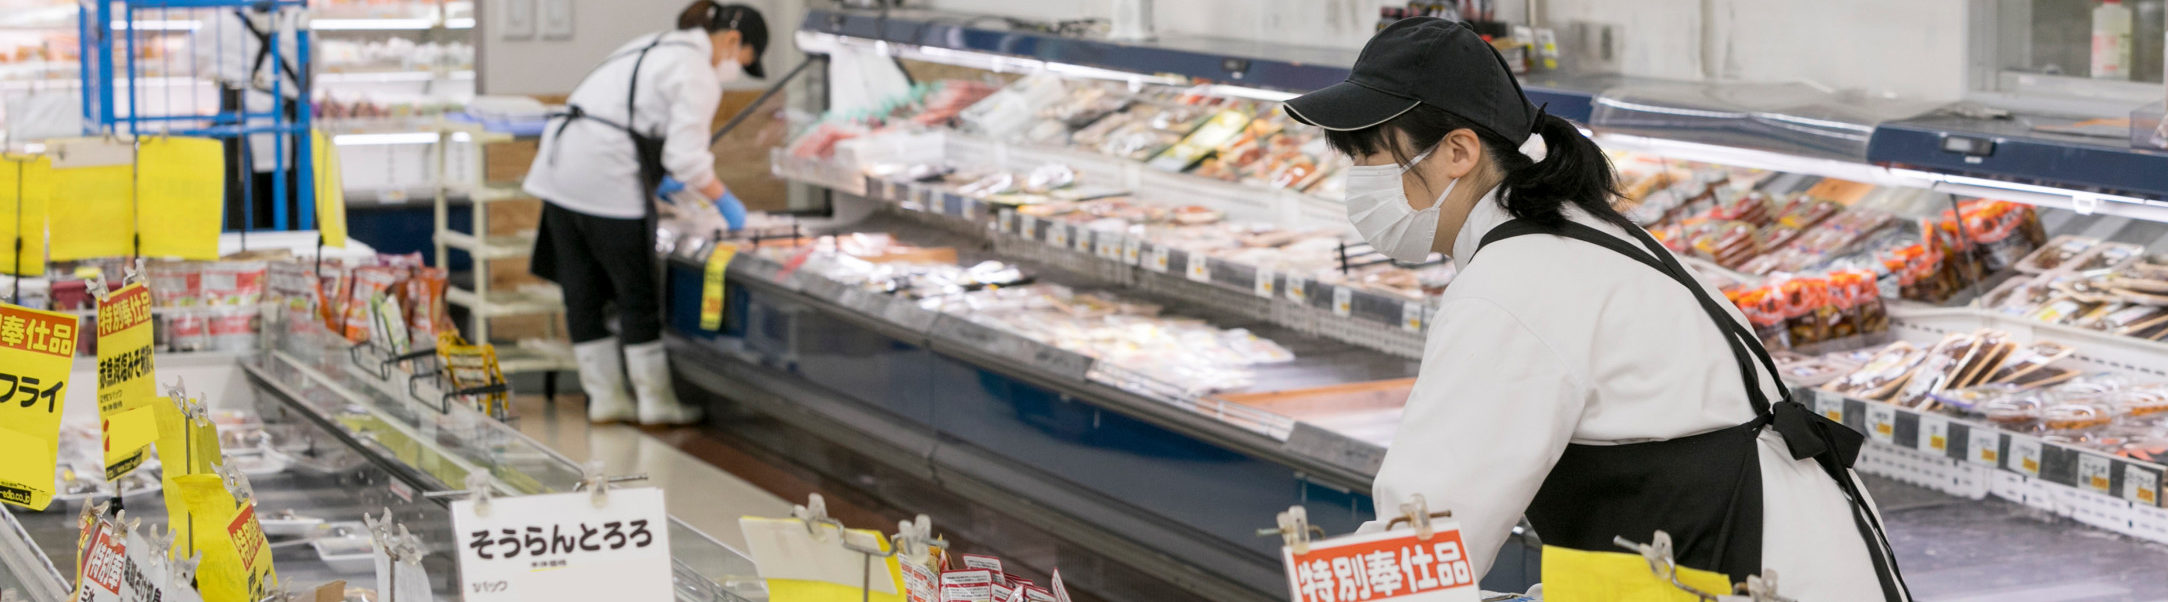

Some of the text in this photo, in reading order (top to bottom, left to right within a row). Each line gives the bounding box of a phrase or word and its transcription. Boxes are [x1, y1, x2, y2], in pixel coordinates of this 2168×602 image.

[0, 314, 72, 356] 奉仕品
[470, 519, 653, 559] そうらんとろろ
[1298, 541, 1471, 602] 特別奉仕品
